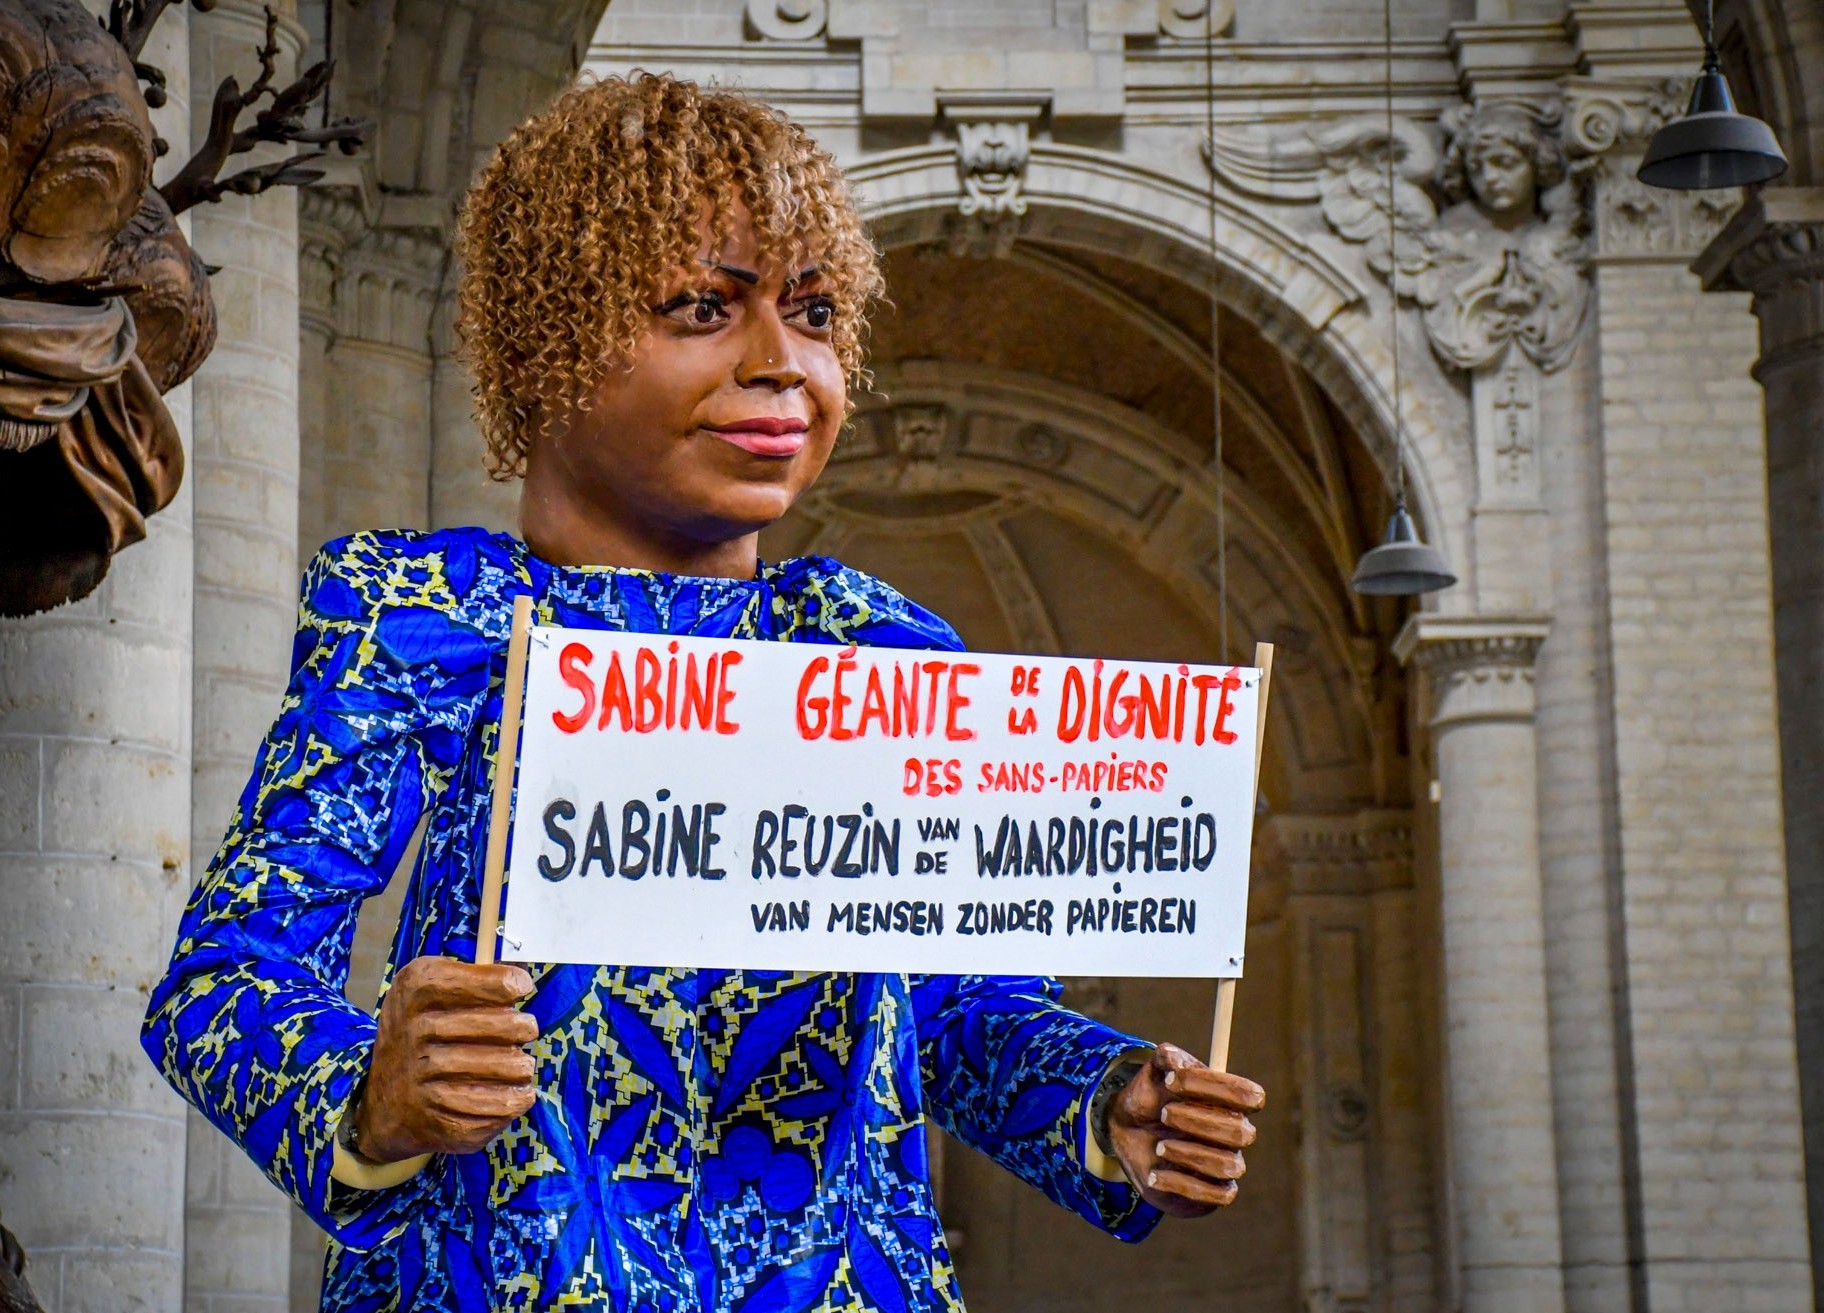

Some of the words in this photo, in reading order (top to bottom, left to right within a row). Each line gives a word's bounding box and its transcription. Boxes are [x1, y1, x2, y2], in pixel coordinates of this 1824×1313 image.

[794, 645, 983, 743] GÉANTE
[1009, 664, 1042, 698] DE
[1007, 706, 1039, 736] LA
[902, 757, 964, 799] DES
[917, 816, 960, 842] VAN
[914, 851, 948, 875] DE
[750, 899, 810, 933] VAN
[827, 900, 944, 936] MENSEN
[955, 899, 1054, 936] ZONDER
